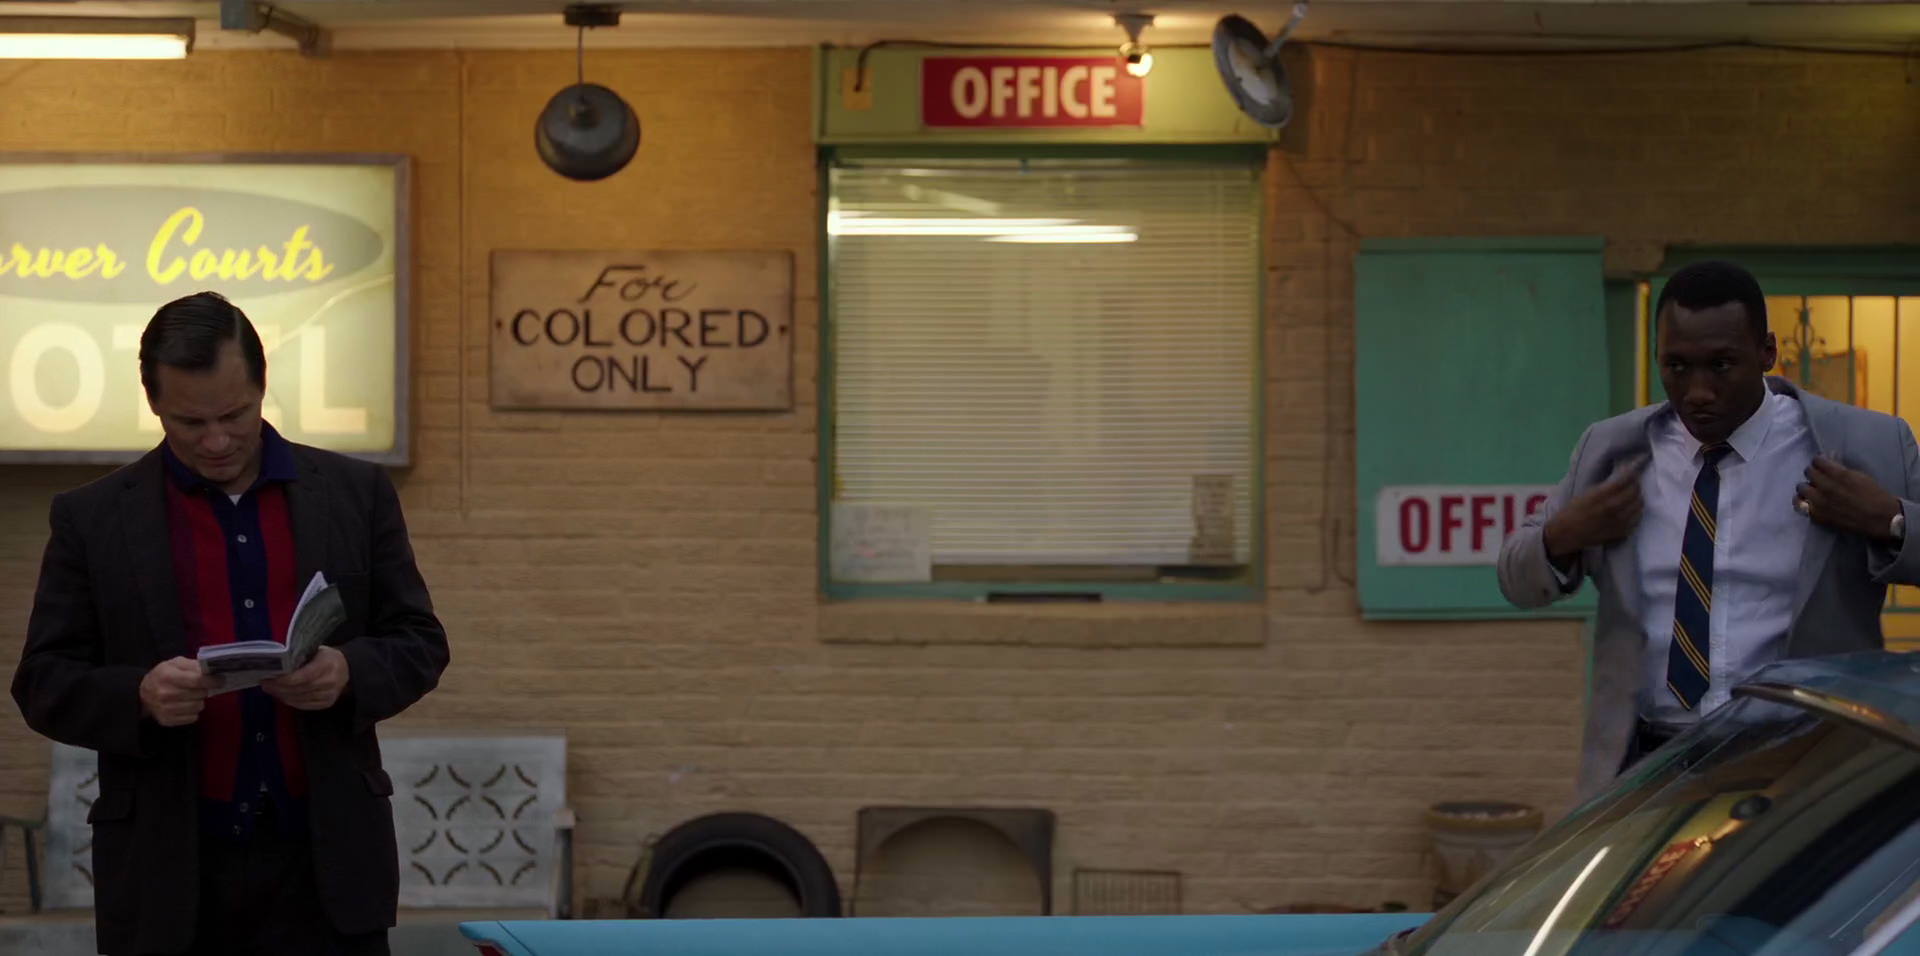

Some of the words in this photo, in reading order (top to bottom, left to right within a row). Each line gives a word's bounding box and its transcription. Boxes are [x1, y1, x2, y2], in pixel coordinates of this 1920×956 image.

[950, 66, 1117, 119] OFFICE
[0, 242, 127, 279] rver
[147, 206, 334, 284] Courts
[577, 264, 696, 304] For
[511, 309, 770, 347] COLORED
[10, 321, 367, 434] OL
[571, 355, 709, 392] ONLY
